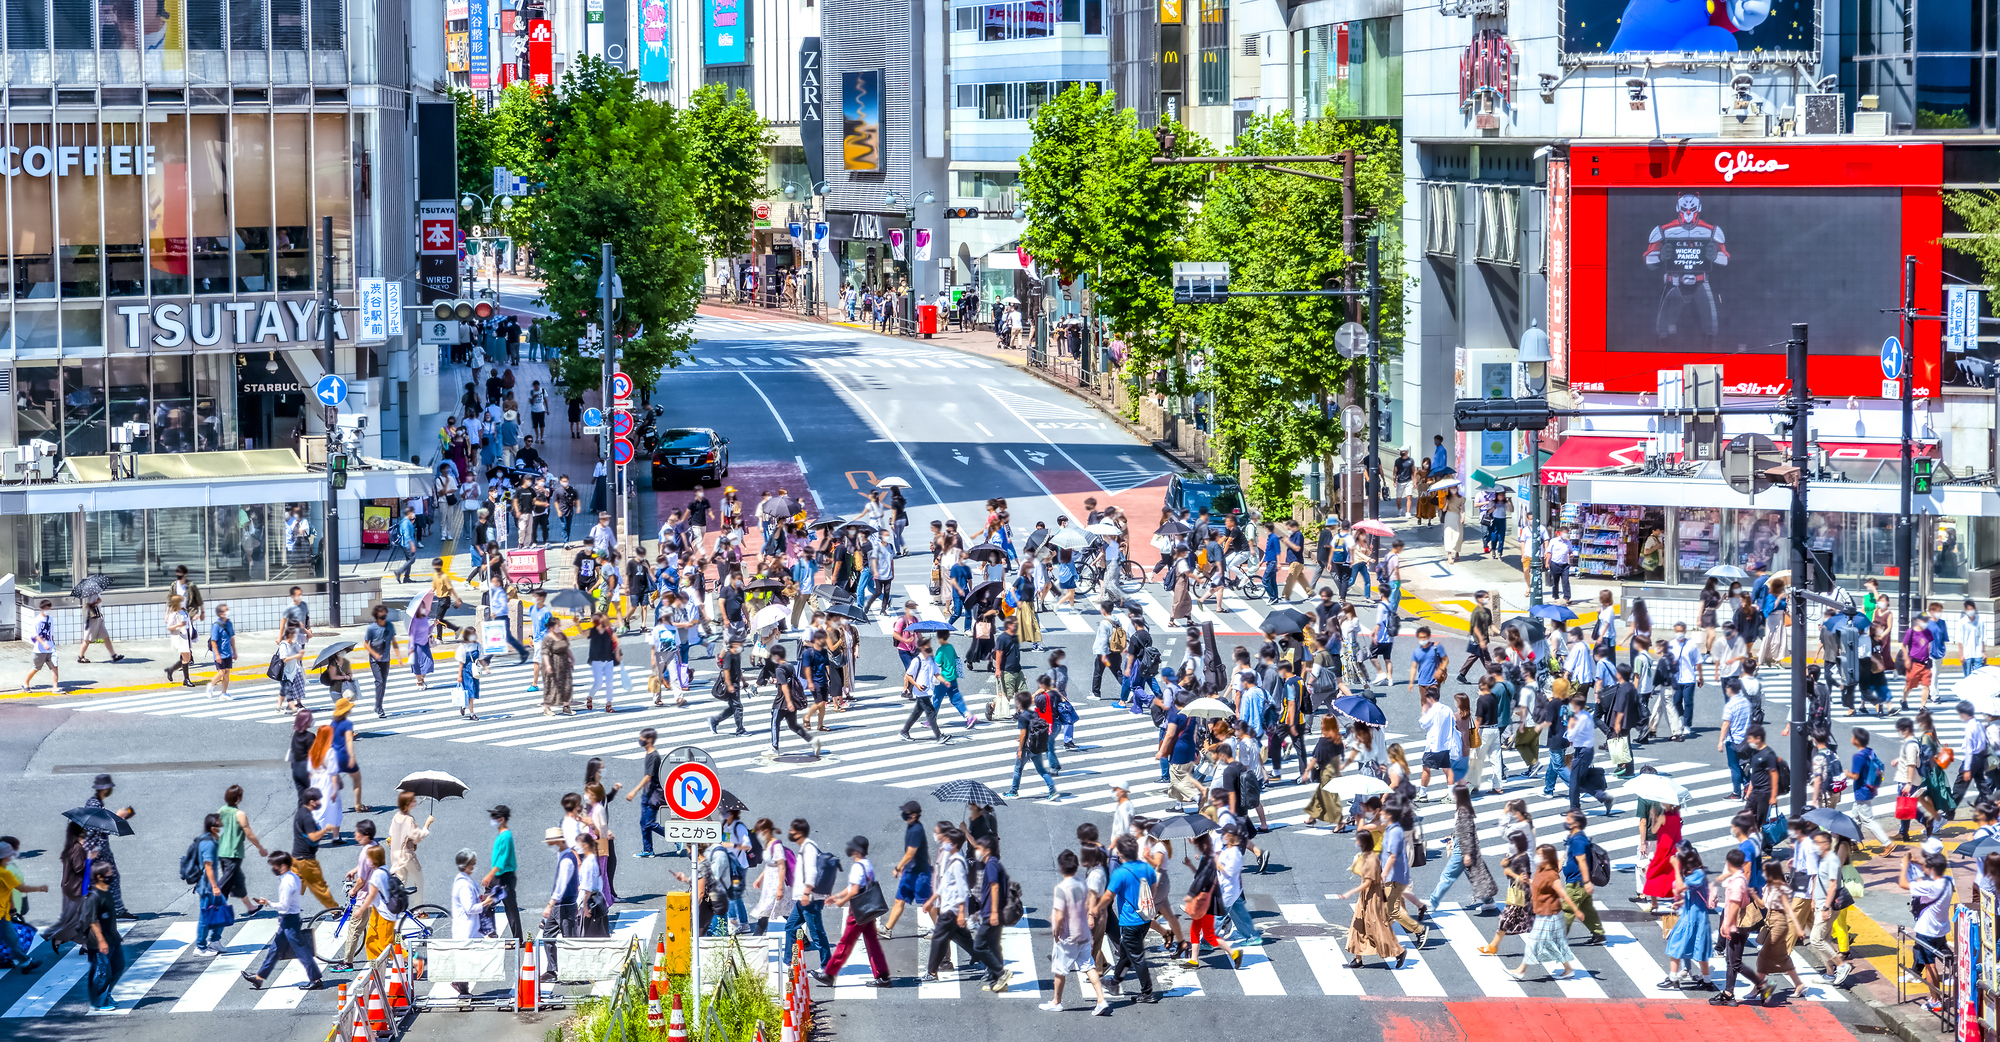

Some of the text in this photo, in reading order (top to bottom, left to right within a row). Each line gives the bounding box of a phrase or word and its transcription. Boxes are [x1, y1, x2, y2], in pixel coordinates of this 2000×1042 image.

[470, 3, 483, 53] 渋谷整形
[802, 51, 821, 122] ZARA
[0, 144, 156, 178] COFFEE
[1715, 151, 1789, 182] Glico
[427, 223, 450, 247] 本
[852, 213, 883, 239] ZARA
[426, 276, 453, 284] WIRED
[362, 290, 370, 314] Shibuya
[370, 283, 382, 335] 渋谷駅前
[389, 284, 399, 333] スクランブル式
[1954, 291, 1963, 346] 渋谷駅前
[117, 298, 349, 349] TSUTAYA
[669, 826, 717, 839] ここから
